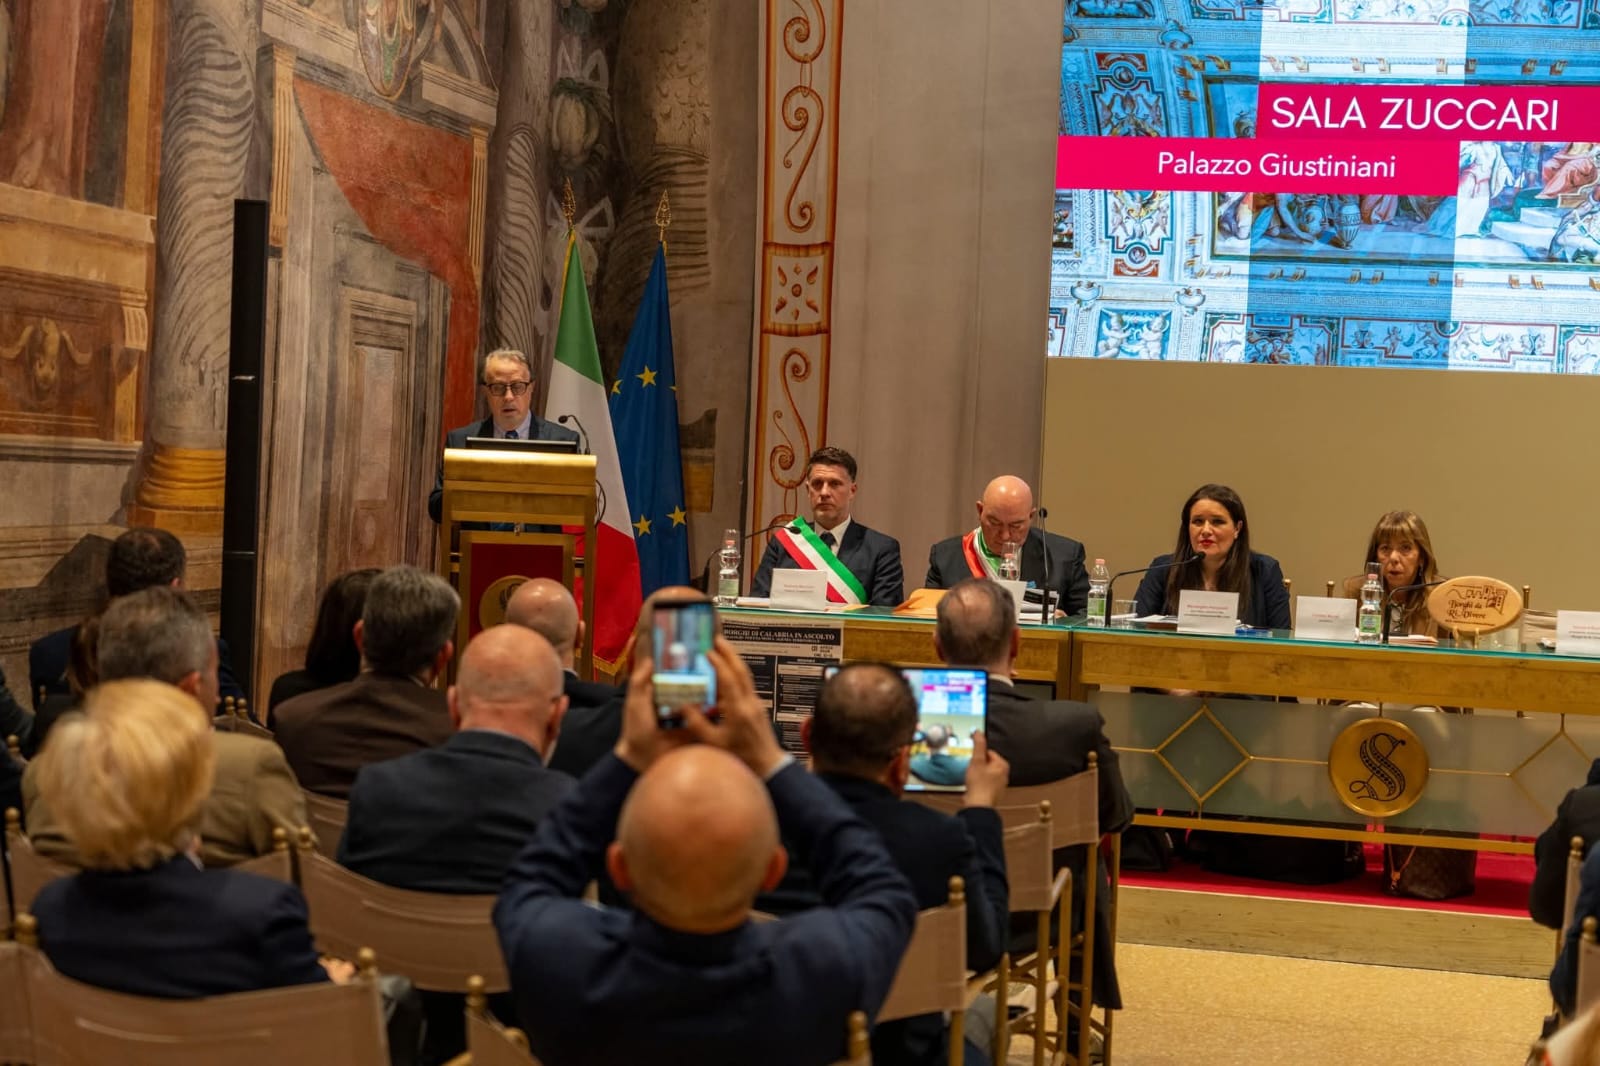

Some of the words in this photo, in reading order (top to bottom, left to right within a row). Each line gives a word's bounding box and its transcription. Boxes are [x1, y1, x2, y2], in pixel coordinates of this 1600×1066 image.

[1271, 95, 1368, 129] SALA
[1378, 97, 1559, 132] ZUCCARI
[1157, 150, 1253, 176] Palazzo
[1258, 152, 1397, 179] Giustiniani
[760, 630, 794, 639] CALABRIA
[803, 633, 835, 641] ASCOLTO
